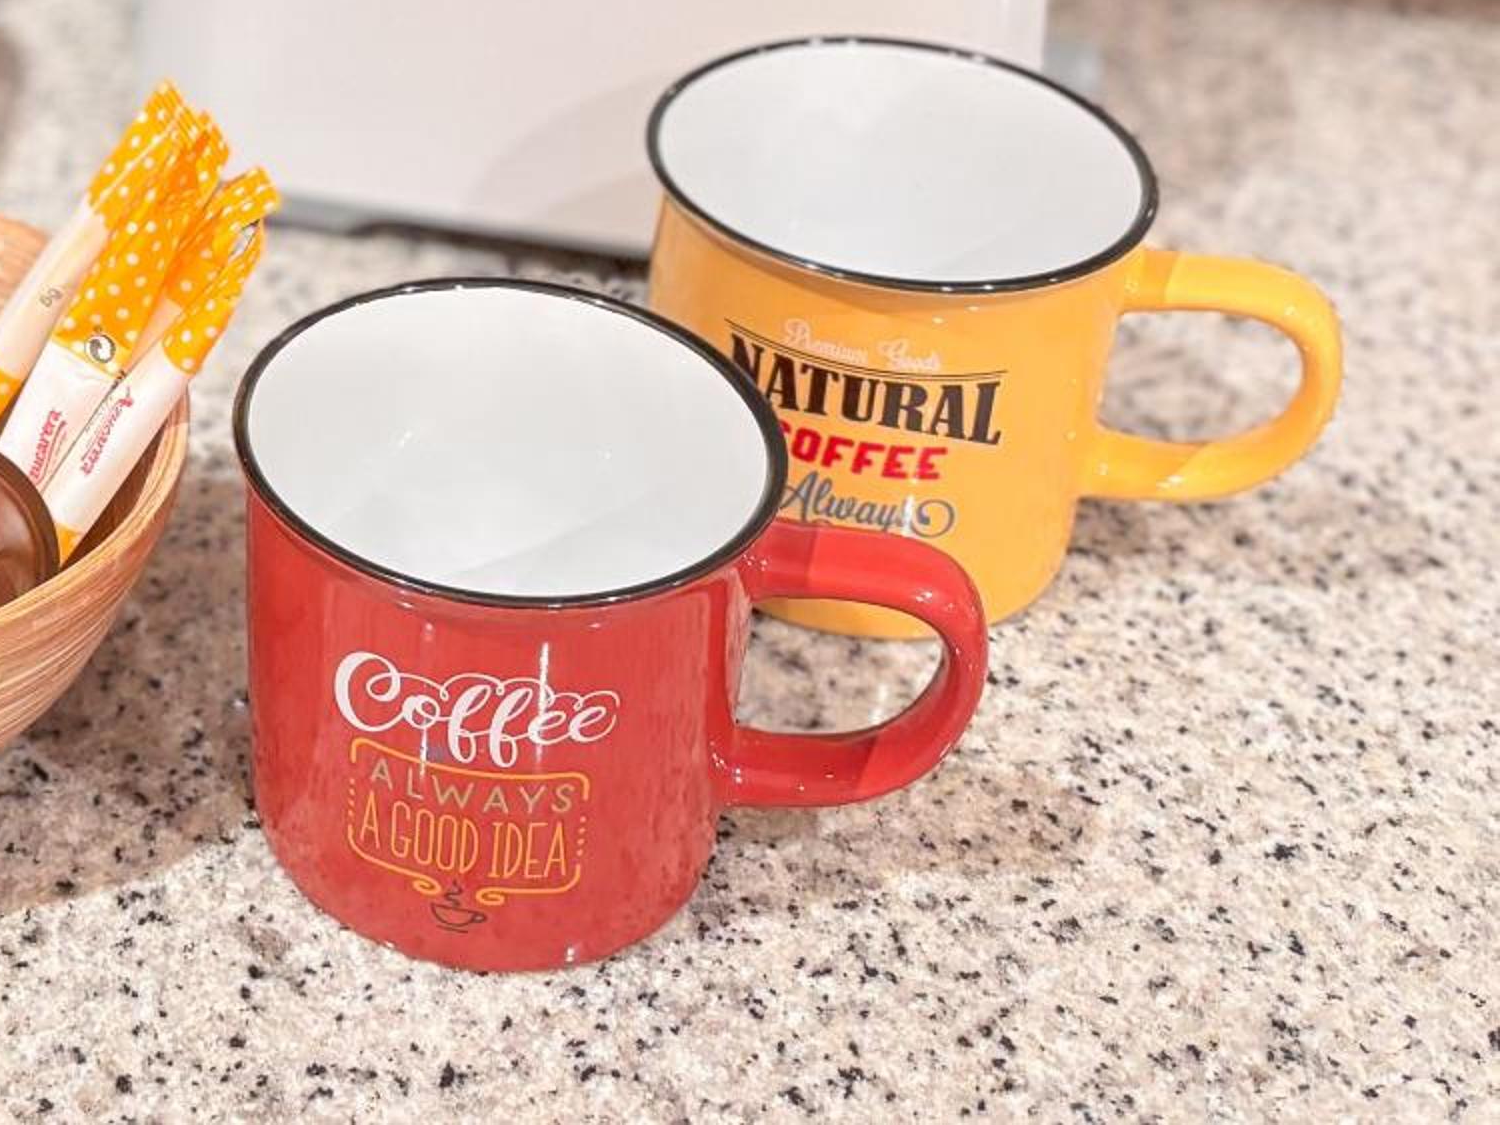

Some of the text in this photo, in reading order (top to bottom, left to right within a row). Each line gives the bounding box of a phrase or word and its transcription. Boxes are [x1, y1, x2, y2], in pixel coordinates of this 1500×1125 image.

[731, 332, 1002, 445] NATURAL
[334, 651, 621, 768] Coffee
[360, 790, 567, 880] A GOOD IDEA
[370, 758, 575, 814] ALWAYS
